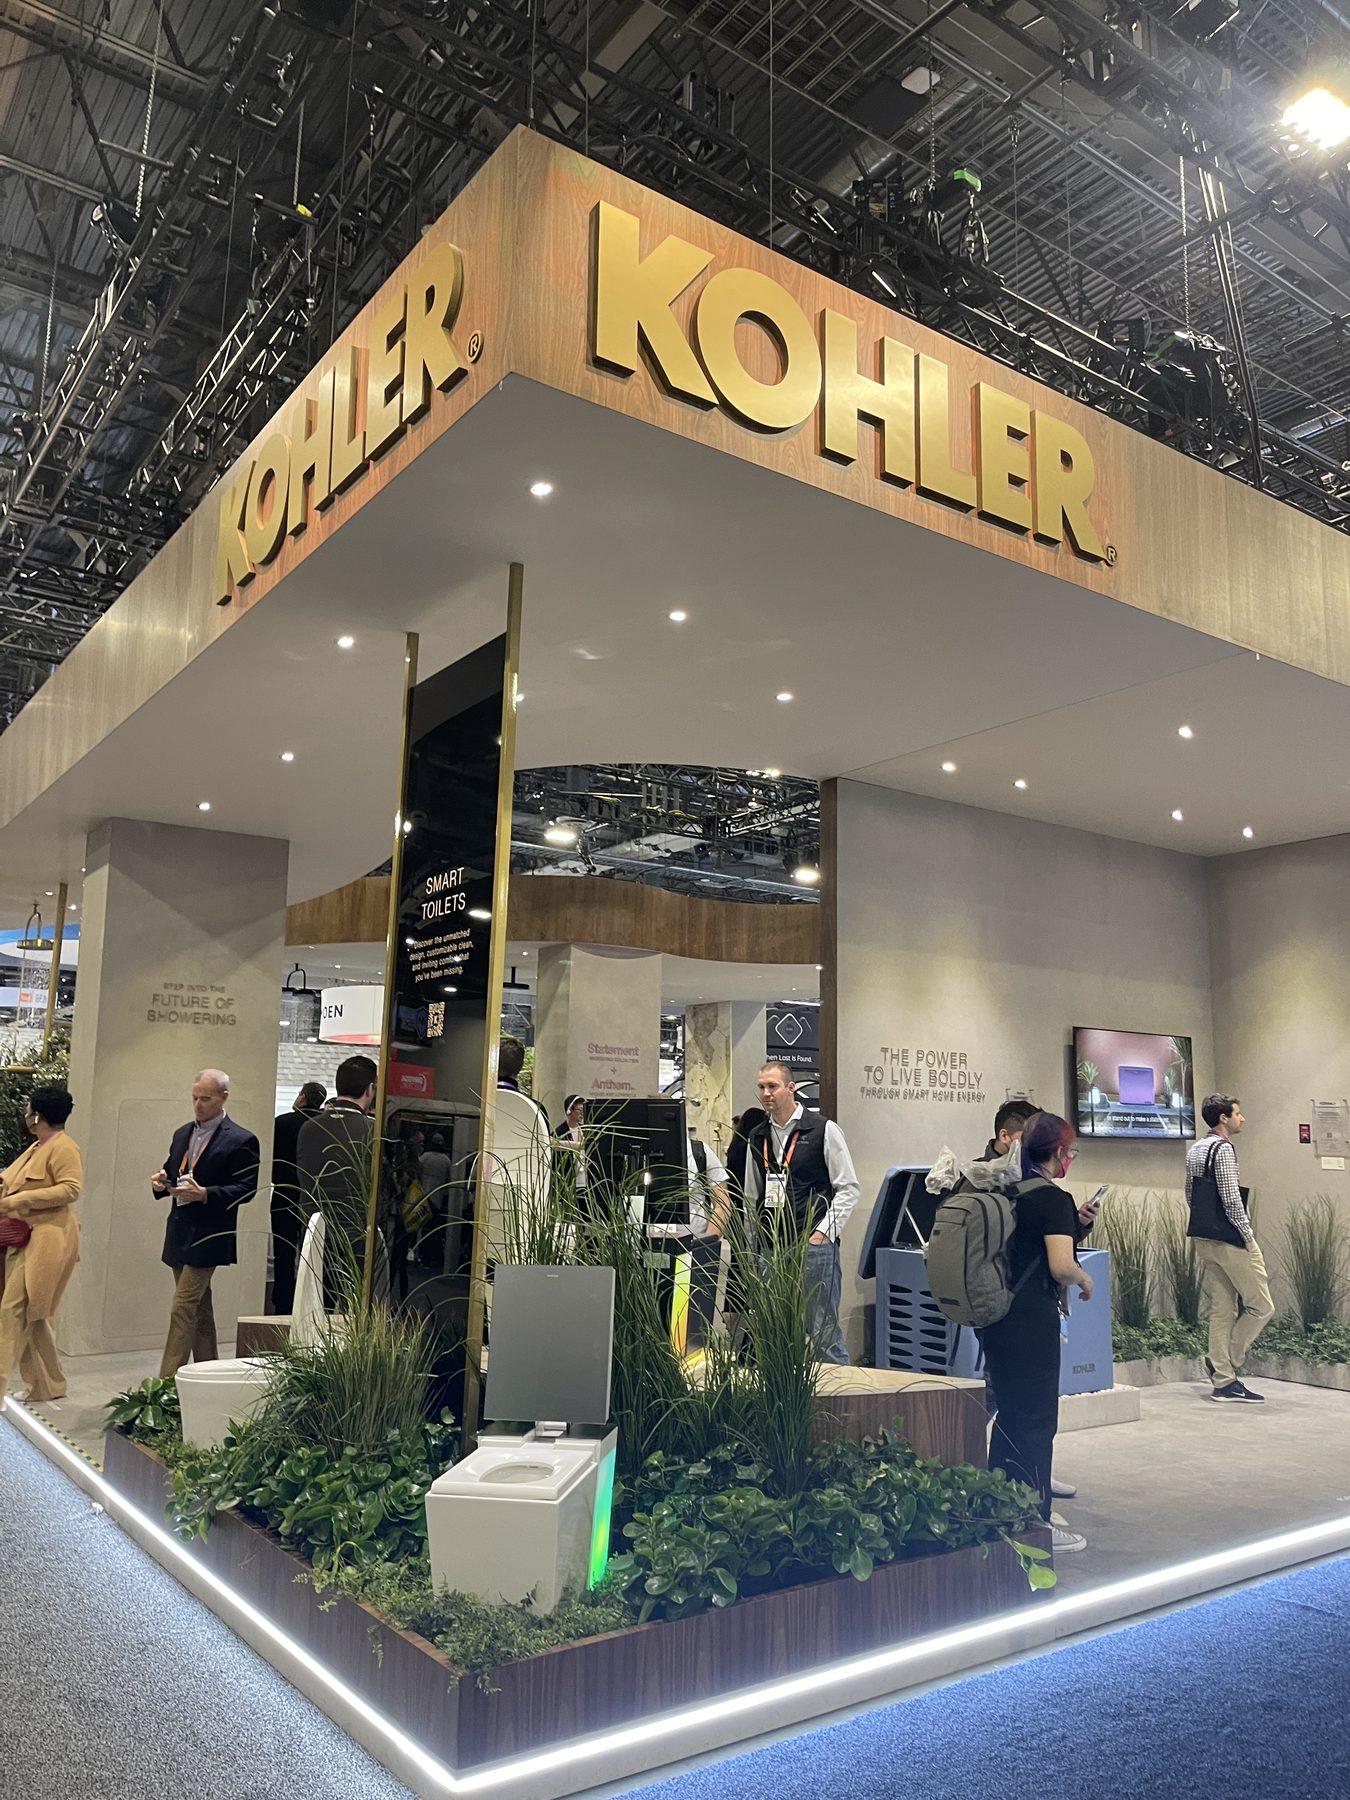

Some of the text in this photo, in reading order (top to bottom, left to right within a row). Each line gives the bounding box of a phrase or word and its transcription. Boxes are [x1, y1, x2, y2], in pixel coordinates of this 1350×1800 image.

[590, 199, 1107, 565] KOHLER
[216, 242, 468, 606] KOHLER
[425, 866, 465, 895] SMART
[421, 892, 466, 920] TOILETS
[152, 993, 235, 1010] FUTURE OF
[147, 1009, 237, 1026] SHOWERING
[880, 1047, 968, 1070] THE POWER
[863, 1065, 983, 1090] TO LIVE BOLDLY
[860, 1086, 986, 1104] THROUGH SMART HOME ENERGY
